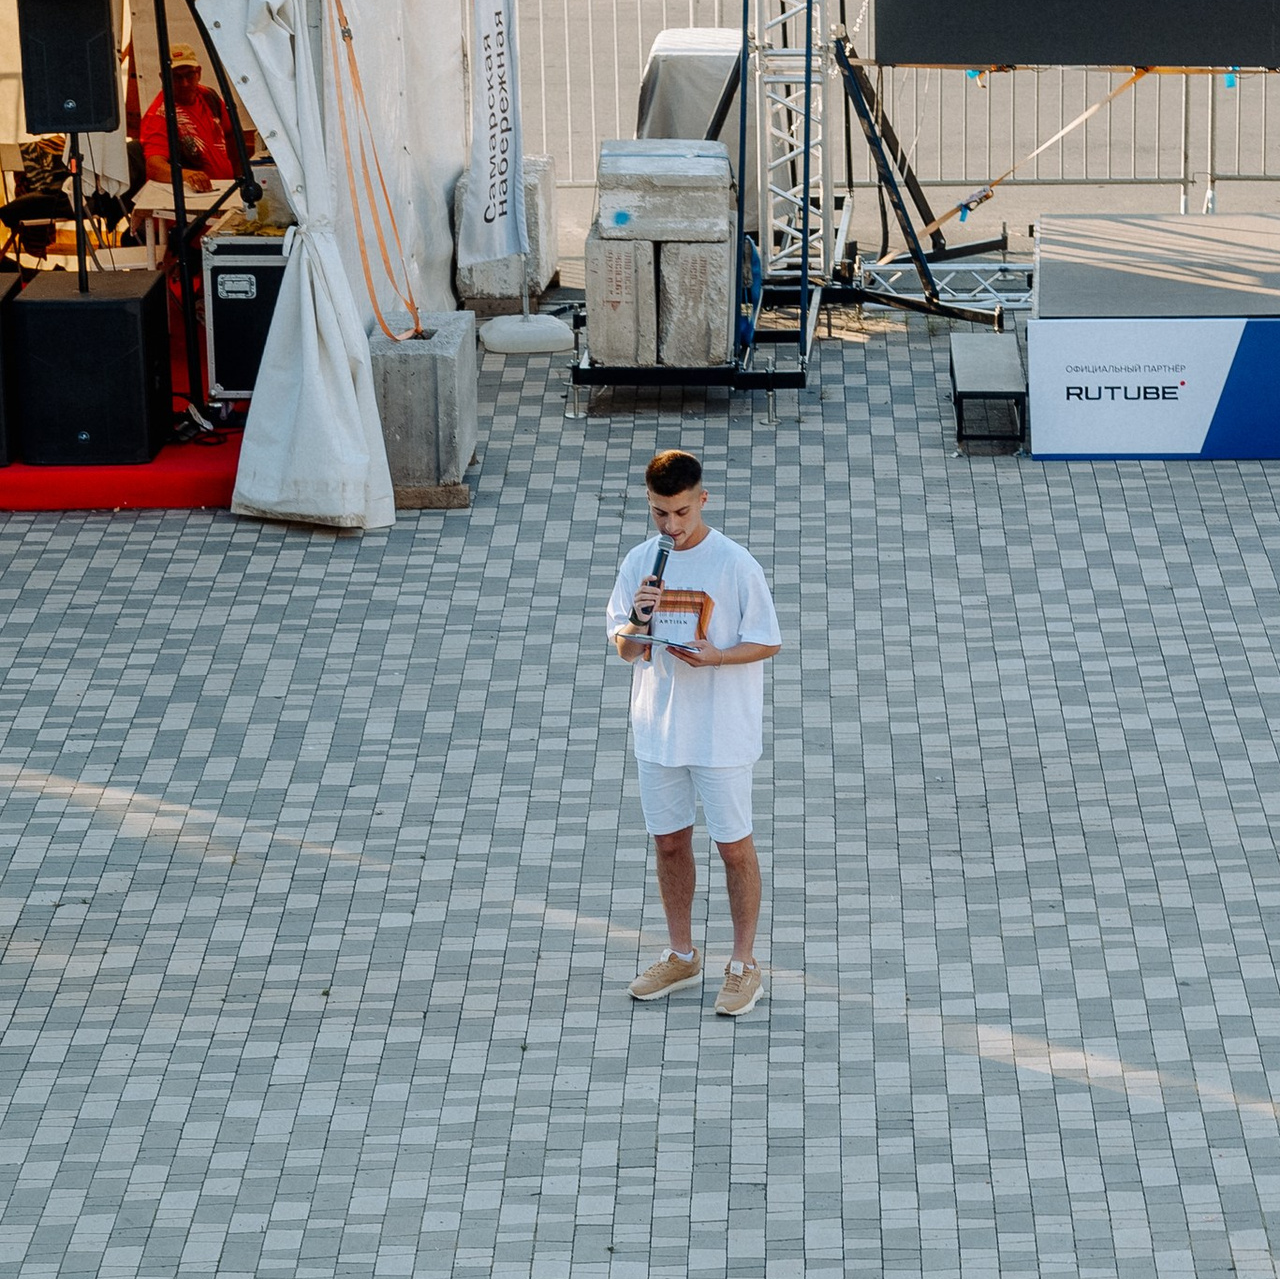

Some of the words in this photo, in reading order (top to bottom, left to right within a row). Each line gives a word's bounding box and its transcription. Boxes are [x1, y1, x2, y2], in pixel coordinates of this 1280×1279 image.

[483, 34, 498, 224] Самарская
[494, 10, 512, 218] набережная
[1065, 364, 1142, 375] ОФИЦИАЛЬНЫЙ
[1065, 385, 1179, 401] RUTUBE
